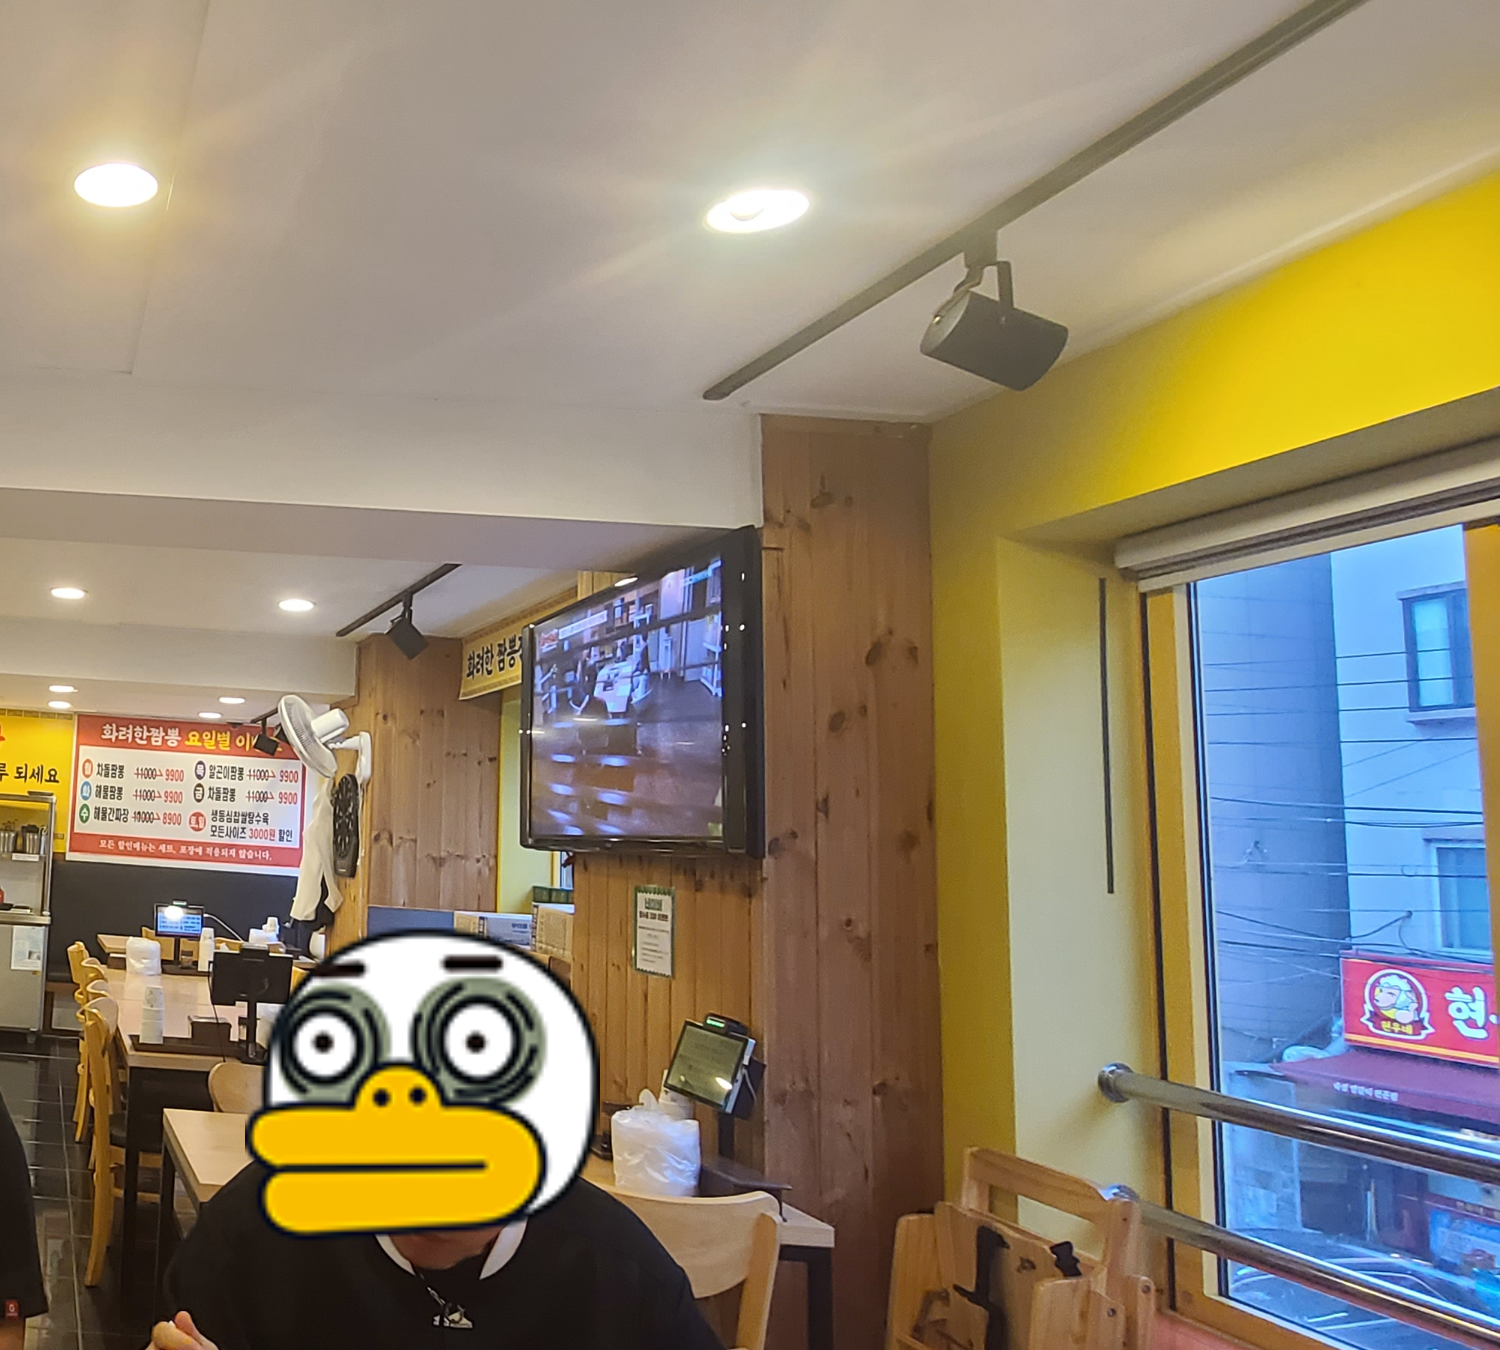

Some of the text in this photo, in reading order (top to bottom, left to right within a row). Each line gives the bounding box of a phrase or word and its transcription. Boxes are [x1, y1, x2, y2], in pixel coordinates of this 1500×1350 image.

[466, 634, 522, 679] 화려한 짬뽕
[101, 723, 182, 747] 화려한짬뽕
[184, 731, 231, 751] 요일별
[13, 763, 60, 784] 되세요
[96, 762, 125, 779] 차돌짬뽕
[165, 768, 185, 782] 9900
[279, 770, 299, 783] 9900
[94, 784, 124, 801] 해물짬뽕
[163, 790, 183, 804] 9900
[278, 791, 298, 805] 9900
[93, 805, 129, 823] 해물간짜장
[162, 812, 182, 826] 8900
[210, 825, 294, 843] 모든사이즈 3000원 할인
[99, 839, 115, 848] 모든
[117, 839, 157, 853] 할인메뉴는
[179, 845, 203, 857] 포장에
[205, 846, 237, 859] 적용되지
[1444, 986, 1499, 1039] 현
[1380, 1020, 1413, 1036] 현우네
